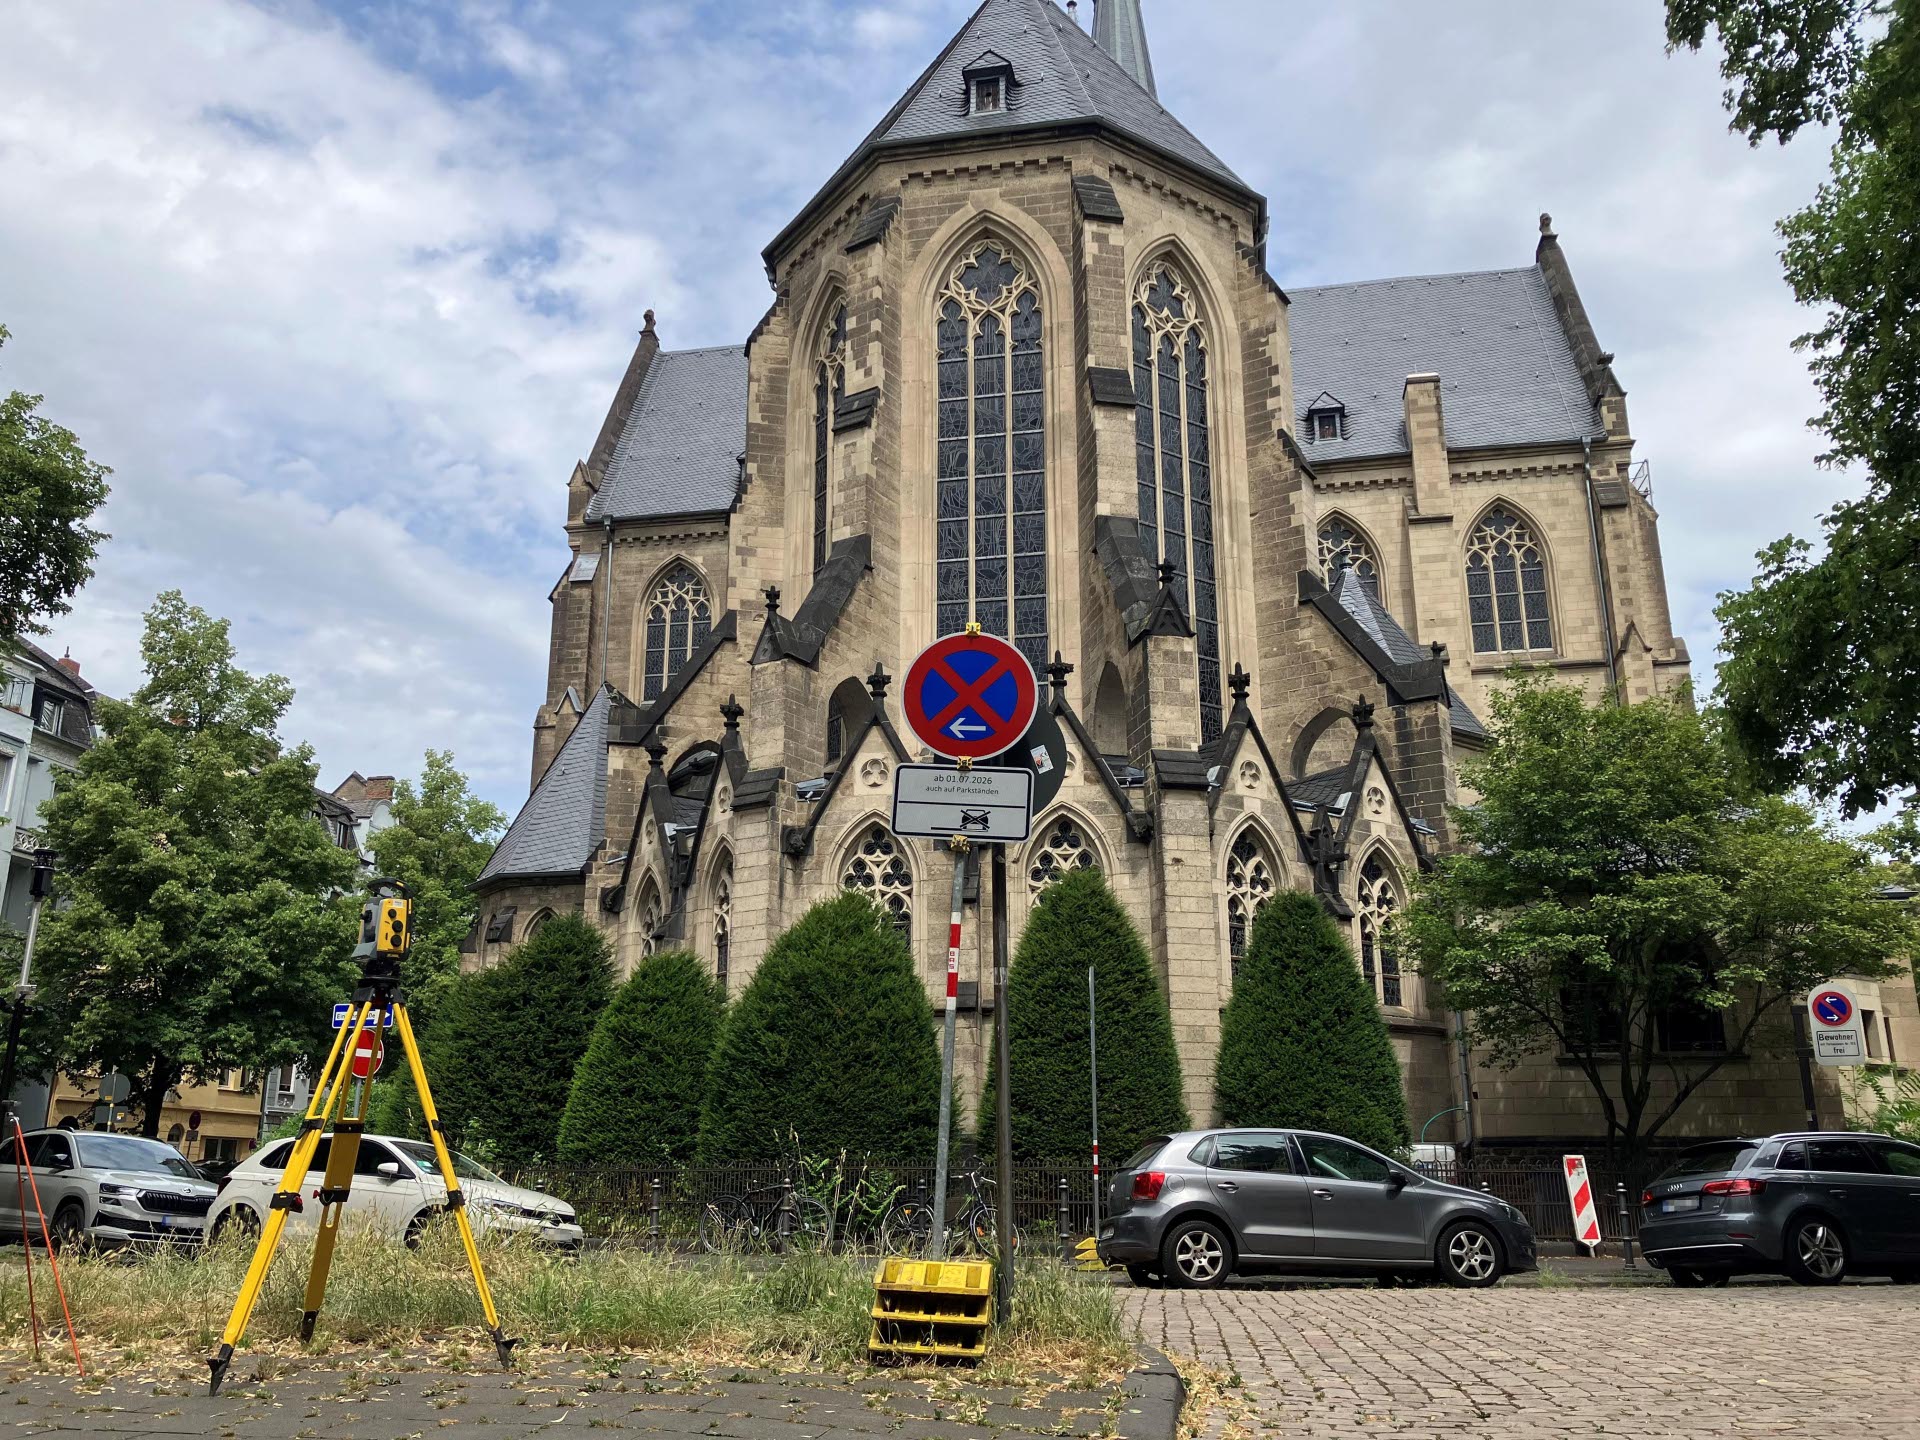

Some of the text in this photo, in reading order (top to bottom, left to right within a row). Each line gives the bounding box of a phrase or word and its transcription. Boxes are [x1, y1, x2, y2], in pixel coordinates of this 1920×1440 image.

[933, 774, 993, 784] ab 01.07.2026
[956, 787, 999, 795] Parkständen
